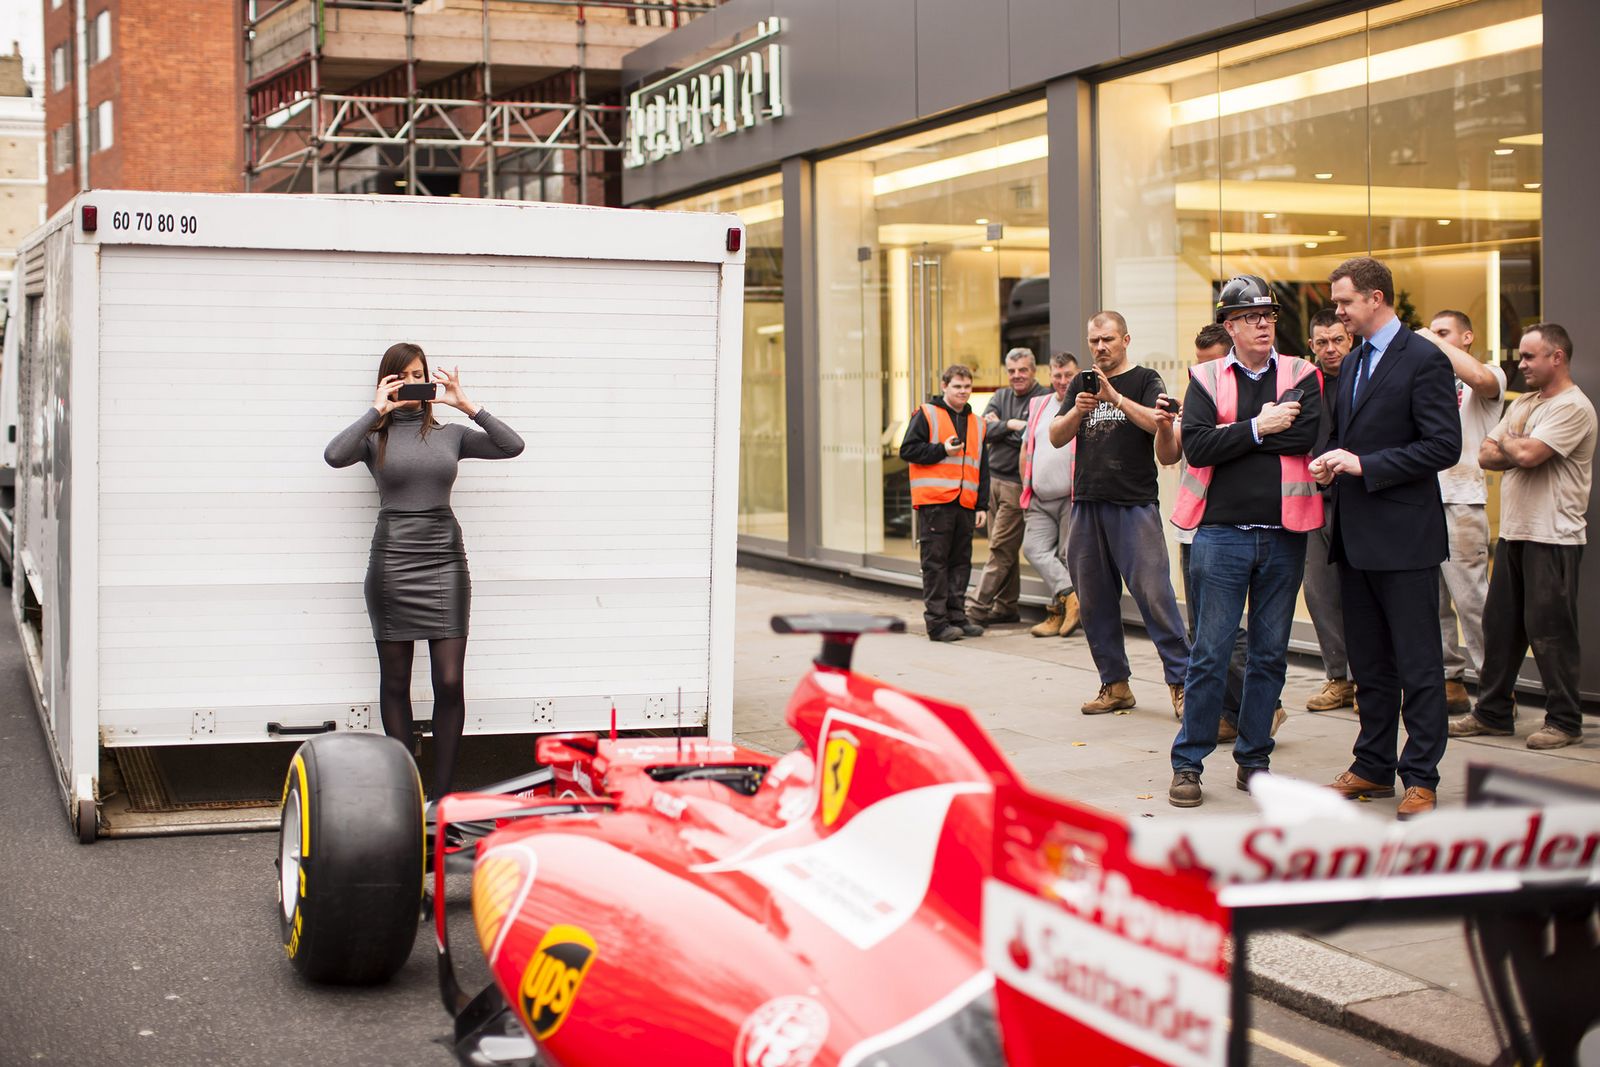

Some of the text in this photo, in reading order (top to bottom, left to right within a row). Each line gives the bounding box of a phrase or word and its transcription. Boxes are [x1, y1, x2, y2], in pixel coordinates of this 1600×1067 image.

[112, 211, 197, 234] 60 70 80 90
[1230, 806, 1600, 884] Santander
[523, 950, 581, 1021] ups
